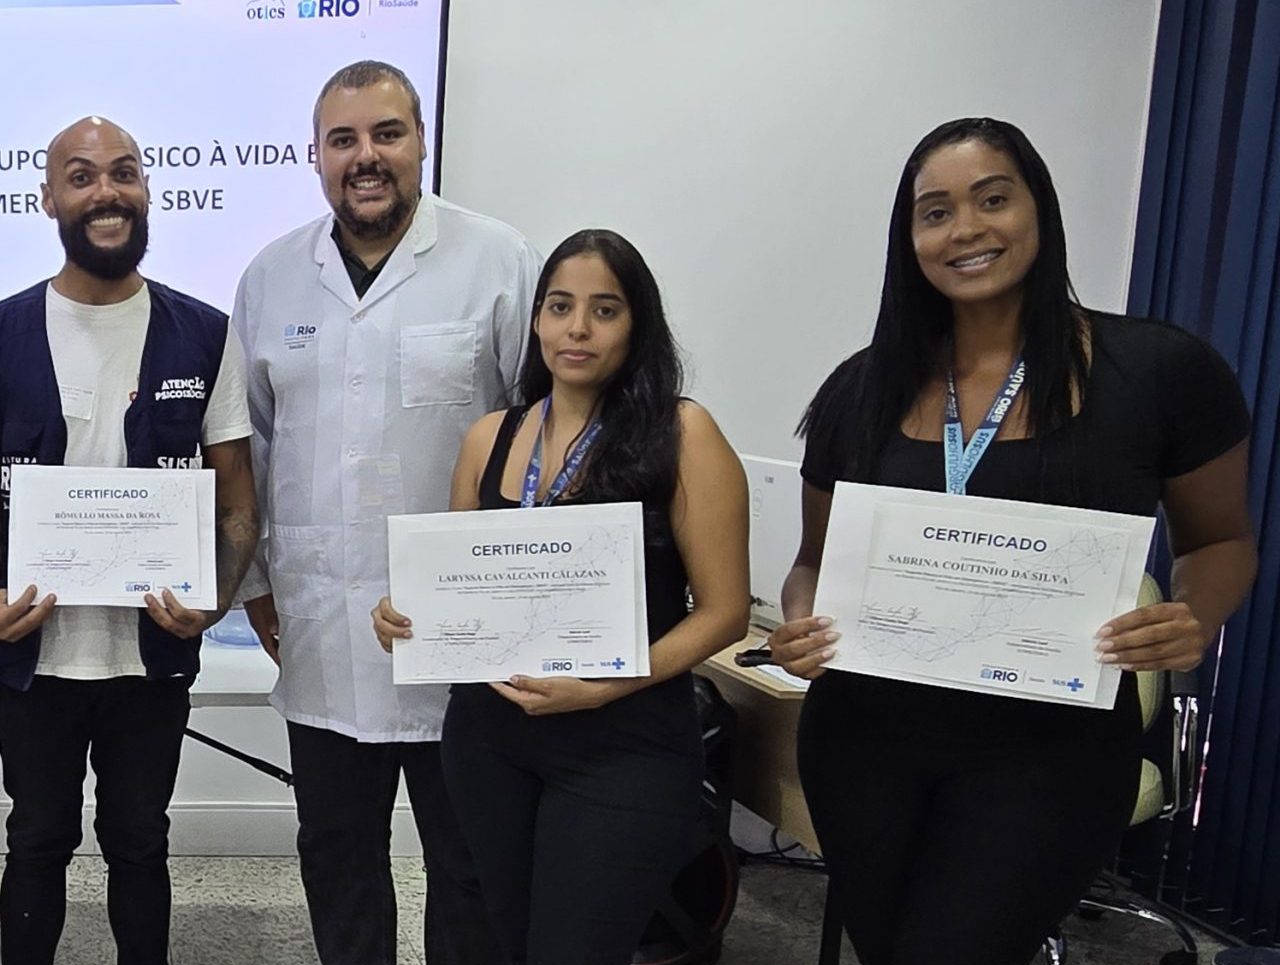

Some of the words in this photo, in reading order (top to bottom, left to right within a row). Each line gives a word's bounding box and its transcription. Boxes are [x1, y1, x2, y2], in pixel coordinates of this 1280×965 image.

[247, 6, 285, 20] otics
[318, 0, 360, 17] RIO
[143, 146, 201, 168] SICO
[209, 139, 227, 167] À
[235, 143, 298, 166] VIDA
[161, 189, 224, 212] SBVE
[297, 325, 316, 336] Rio
[68, 489, 149, 499] CERTIFICADO
[922, 526, 1048, 553] CERTIFICADO
[472, 541, 572, 556] CERTIFICADO
[438, 573, 482, 583] LARYSSA
[484, 571, 550, 582] CAVALCANTI
[887, 554, 939, 569] SABRINA
[942, 560, 1008, 577] COUTINHO
[1010, 569, 1028, 579] DA
[1030, 571, 1070, 585] SILVA
[134, 584, 150, 592] RIO
[552, 661, 572, 671] RIO
[992, 668, 1018, 683] RIO
